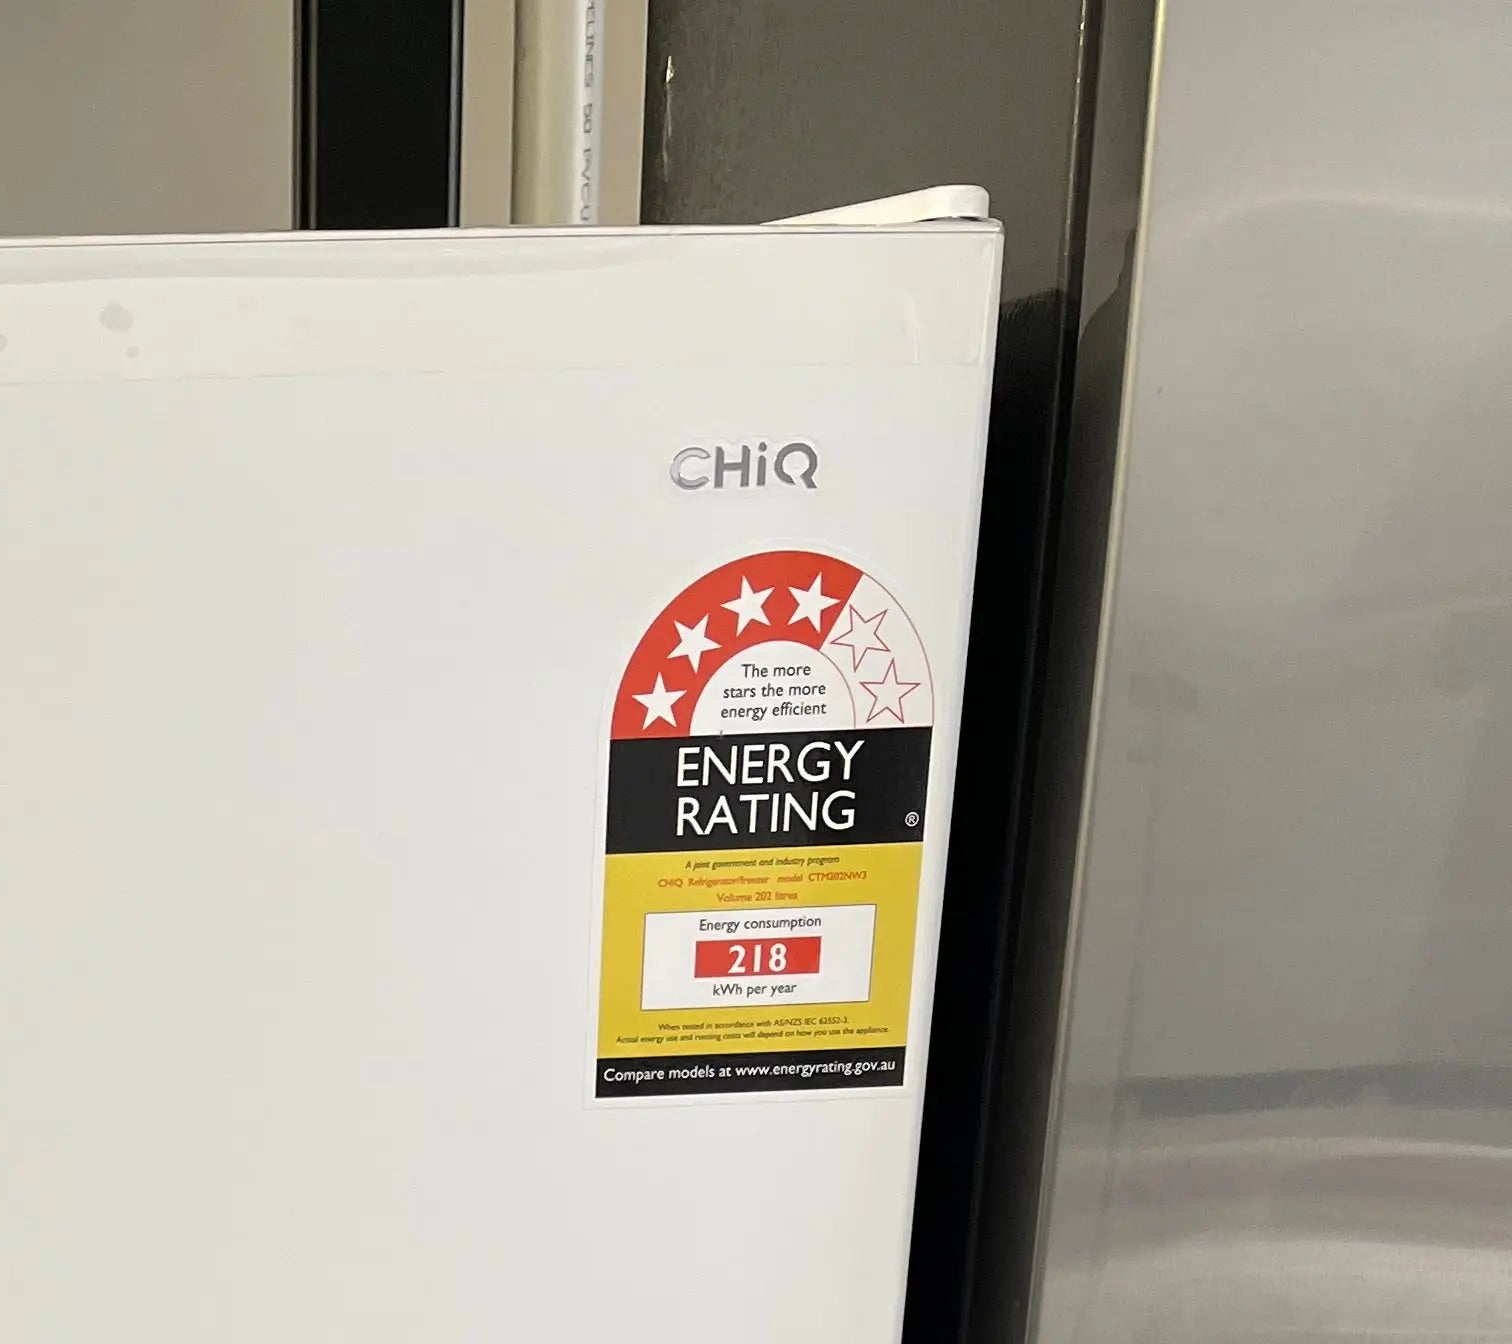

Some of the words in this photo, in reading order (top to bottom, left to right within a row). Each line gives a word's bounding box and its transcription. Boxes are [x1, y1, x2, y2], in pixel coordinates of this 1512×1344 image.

[669, 441, 818, 490] CHiQ
[742, 663, 769, 679] The
[773, 664, 811, 678] more
[723, 685, 757, 699] stars
[761, 683, 785, 698] the
[788, 683, 827, 697] more
[720, 704, 768, 722] energy
[772, 701, 827, 717] efficient
[676, 740, 865, 787] ENERGY
[676, 790, 856, 836] RATING
[807, 856, 840, 866] program
[716, 892, 753, 903] Volume
[755, 891, 772, 901] 202
[699, 918, 740, 934] Energy
[744, 915, 822, 932] consumption
[728, 942, 788, 975] 218
[713, 983, 743, 997] kWh
[746, 984, 767, 999] per
[770, 982, 798, 998] year
[604, 1067, 665, 1084] Compare
[668, 1062, 715, 1080] models
[719, 1066, 732, 1078] at
[735, 1059, 896, 1079] www.energyrating.gov.au
